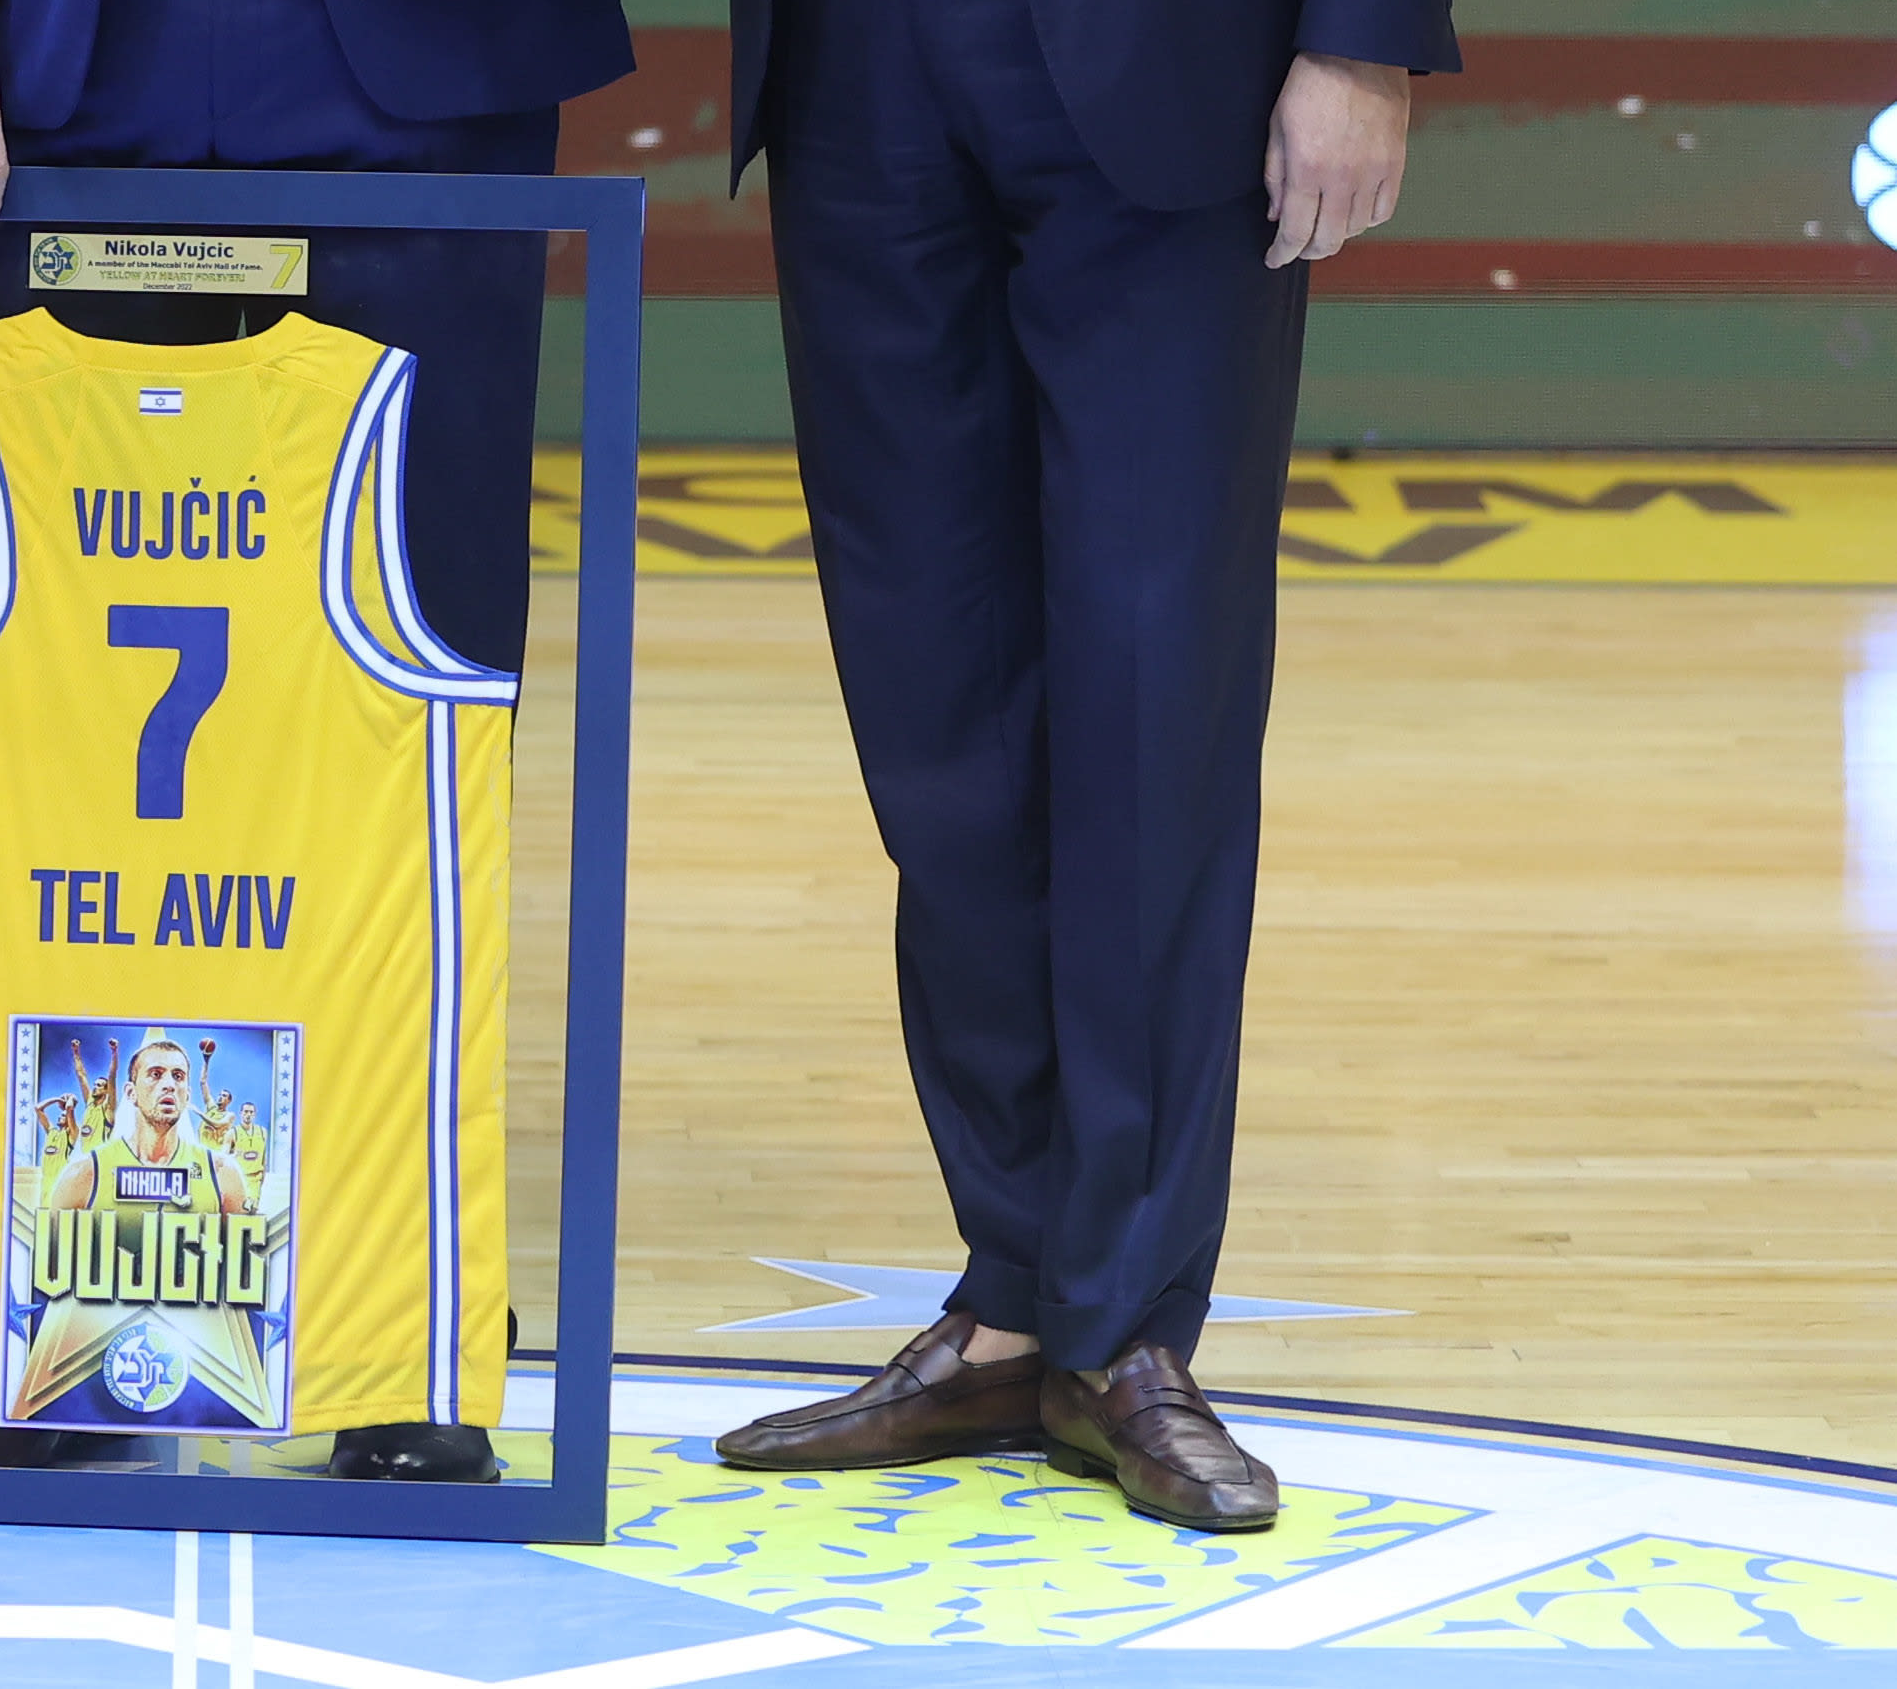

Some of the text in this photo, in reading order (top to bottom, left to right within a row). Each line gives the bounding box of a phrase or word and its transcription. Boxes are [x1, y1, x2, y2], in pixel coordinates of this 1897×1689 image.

[87, 259, 94, 267] A
[95, 260, 125, 268] member
[151, 261, 182, 269] Maccabi
[105, 240, 234, 261] Nikola Vujcic
[270, 244, 304, 289] 7
[100, 270, 142, 280] YELLOW
[144, 271, 157, 280] AT
[159, 271, 193, 281] HEART
[73, 475, 267, 560] VUJČIĆ
[107, 604, 229, 819] 7
[30, 868, 296, 950] TEL AVIV
[120, 1169, 184, 1197] NIKOLA
